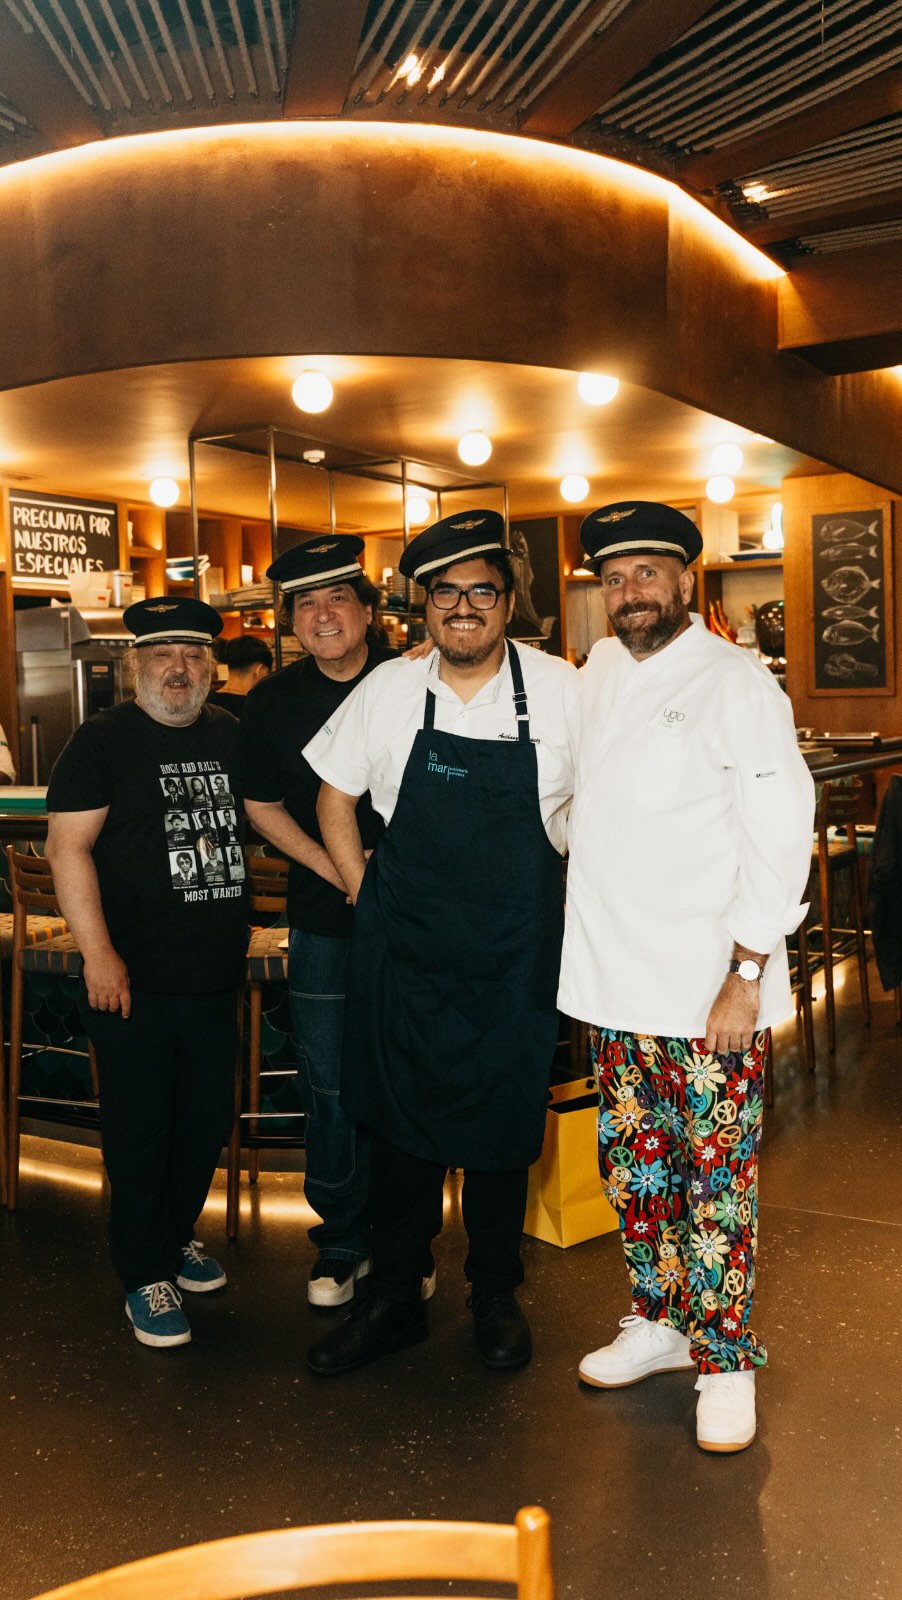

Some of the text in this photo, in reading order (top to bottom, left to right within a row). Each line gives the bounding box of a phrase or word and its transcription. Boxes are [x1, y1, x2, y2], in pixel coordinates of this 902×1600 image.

[13, 506, 111, 536] PREGUNTA POR
[14, 529, 87, 555] NUESTROS
[15, 552, 104, 576] ESPECIALES
[429, 749, 438, 761] la
[160, 763, 180, 774] ROCK
[181, 762, 196, 773] AND
[427, 762, 448, 774] mar
[183, 889, 209, 902] MOST
[212, 885, 242, 899] WANTED
